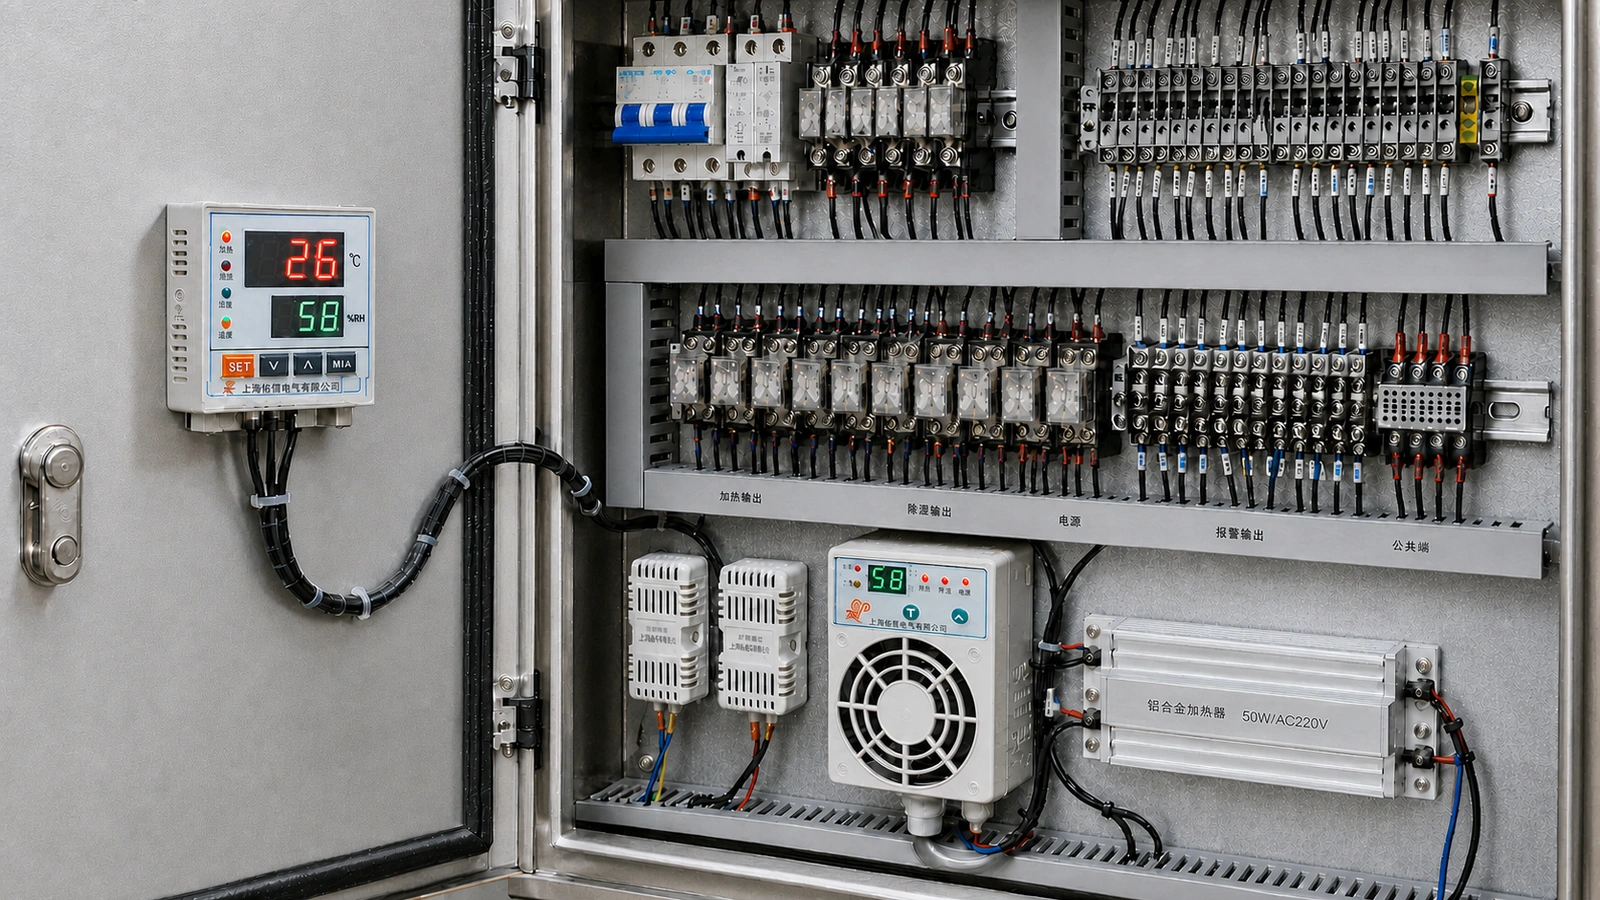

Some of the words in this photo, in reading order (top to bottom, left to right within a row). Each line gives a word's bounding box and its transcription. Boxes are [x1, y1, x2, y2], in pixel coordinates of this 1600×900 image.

[286, 239, 338, 280] 26
[299, 301, 340, 332] 58
[347, 314, 365, 323] %RH
[228, 361, 251, 373] SET
[332, 360, 352, 369] MIA
[719, 490, 762, 504] 加热输出
[907, 503, 952, 518] 除湿输出
[1059, 514, 1082, 528] 电源
[1215, 526, 1264, 542] 报警输出
[1392, 540, 1430, 554] 公共端
[872, 567, 904, 591] 58
[906, 607, 916, 618] T
[1147, 699, 1226, 719] 铝合金加热器
[1242, 710, 1329, 730] 50W/AC220V
